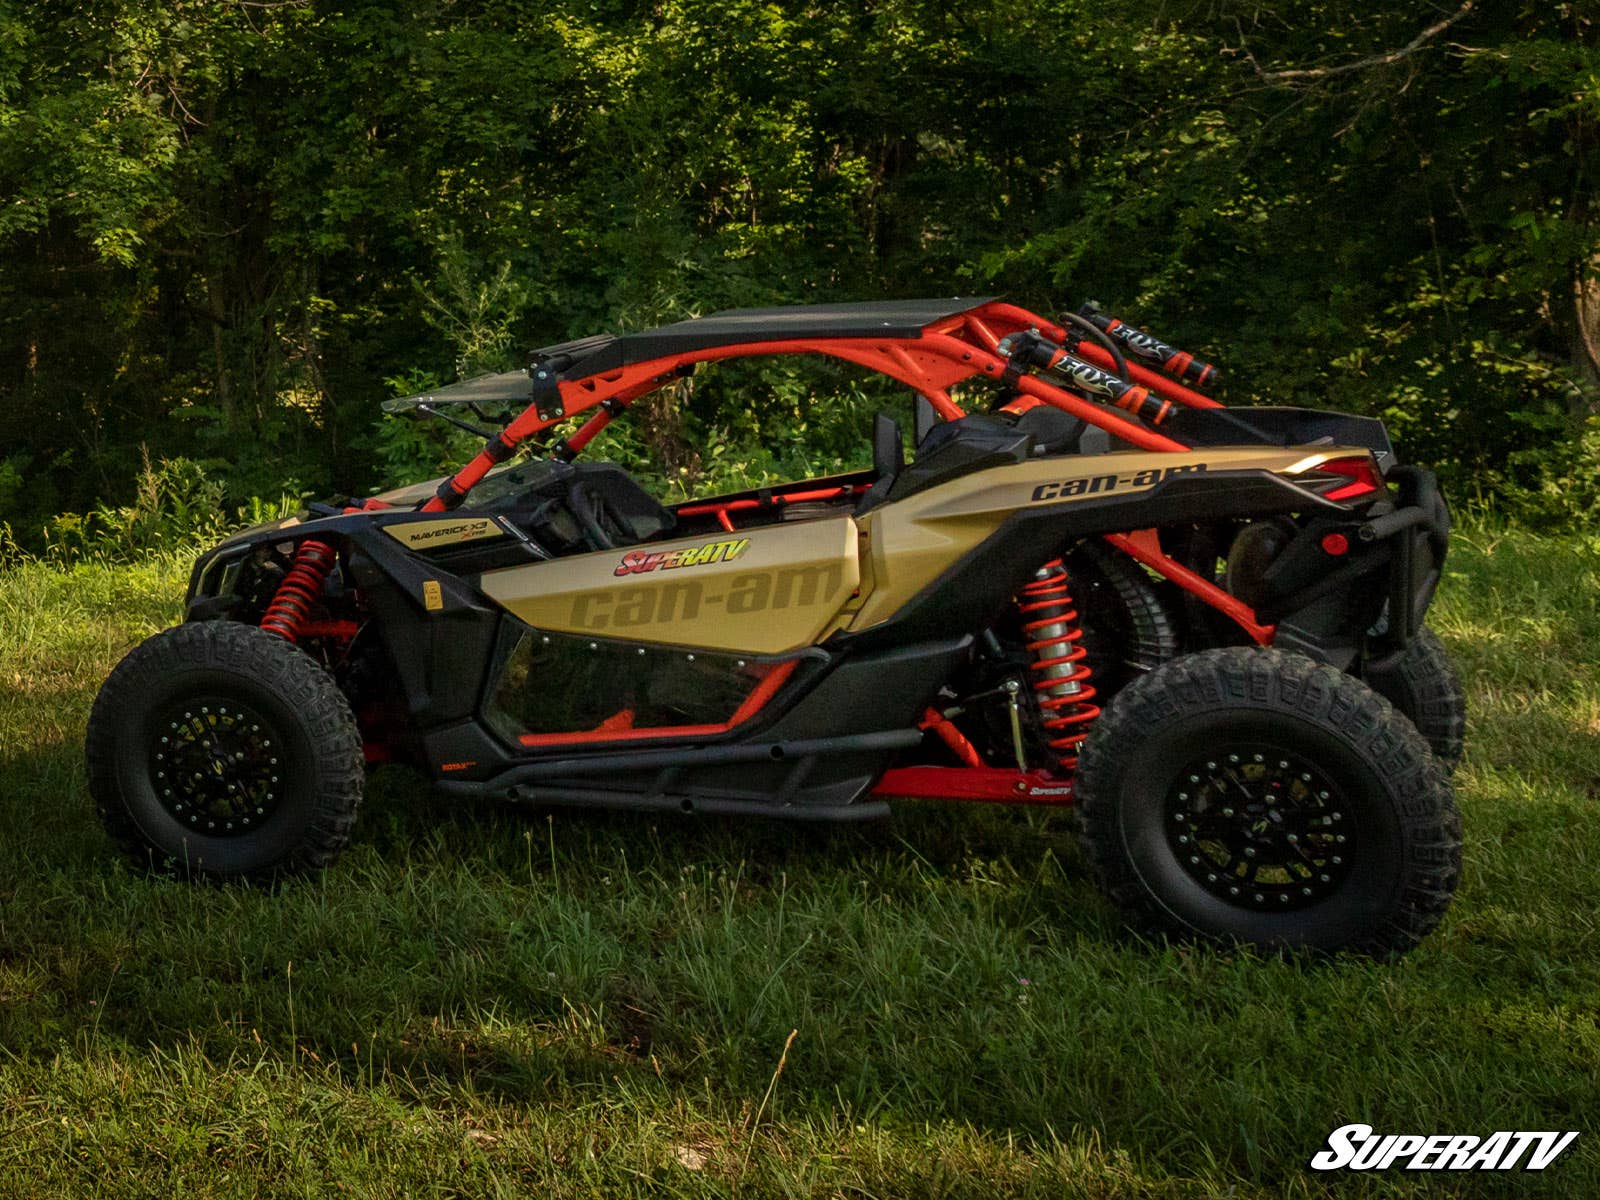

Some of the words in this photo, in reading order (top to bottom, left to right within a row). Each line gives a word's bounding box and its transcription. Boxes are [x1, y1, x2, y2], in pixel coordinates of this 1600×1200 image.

[1053, 354, 1123, 398] FOX
[410, 524, 468, 541] MAVERICK
[570, 565, 842, 629] can-am
